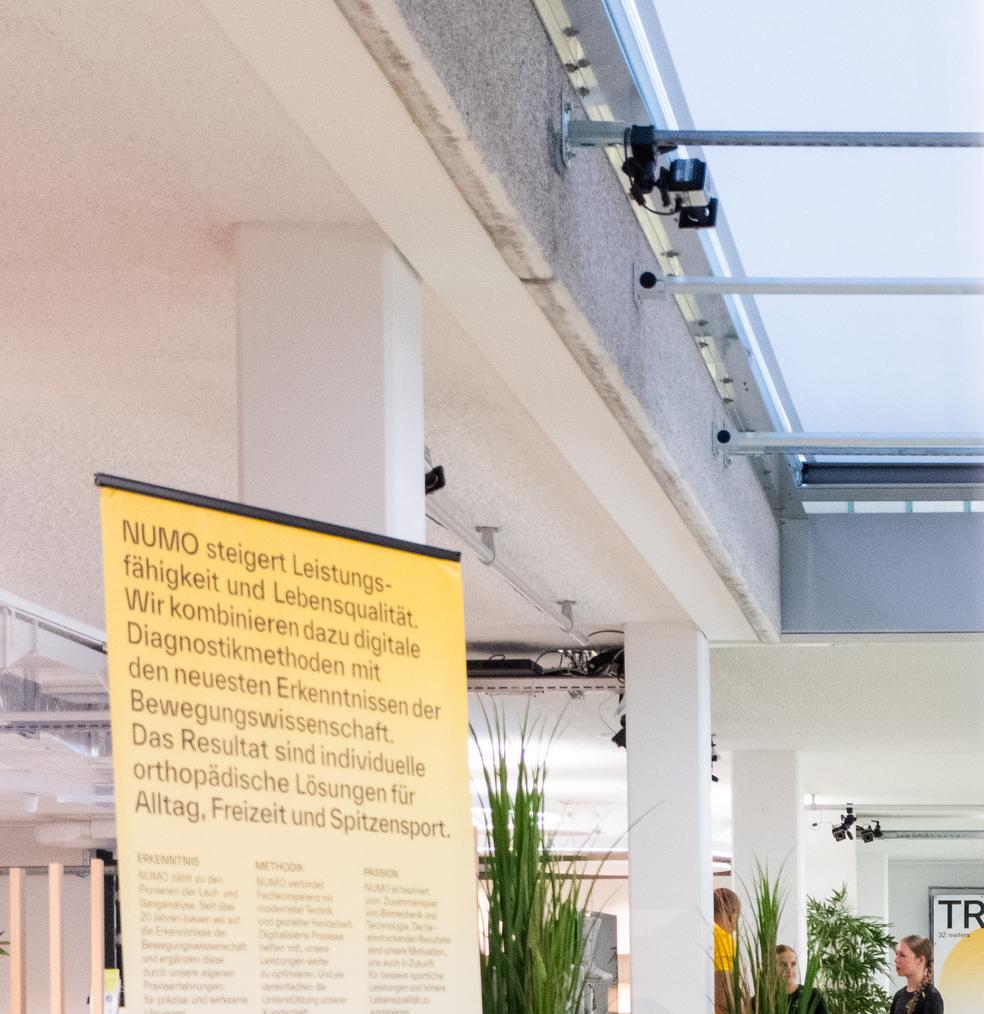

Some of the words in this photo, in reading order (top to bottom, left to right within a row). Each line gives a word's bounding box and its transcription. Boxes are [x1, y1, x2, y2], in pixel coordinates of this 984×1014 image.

[122, 519, 199, 555] NUMO
[206, 543, 287, 573] steigert
[293, 556, 392, 594] Leistungs-
[123, 555, 219, 592] fähigkeit
[227, 577, 264, 600] und
[274, 582, 418, 629] Lebensqualität.
[125, 588, 165, 614] Wir
[170, 597, 299, 637] kombinieren
[304, 623, 349, 647] dazu
[354, 631, 421, 659] digitale
[128, 622, 344, 677] Diagnostikmethoden
[352, 664, 381, 682] mit
[129, 658, 169, 683] den
[175, 667, 271, 696] neuesten
[278, 677, 408, 715] Erkenntnissen
[413, 700, 441, 720] der
[132, 689, 394, 744] Bewegungswissenschaft.
[132, 723, 174, 749] Das
[182, 729, 269, 760] Resultat
[276, 743, 315, 765] sind
[321, 745, 425, 778] individuelle
[134, 761, 289, 794] orthopädische
[296, 775, 386, 805] Lösungen
[392, 783, 415, 805] für
[135, 791, 206, 824] Alltag,
[212, 798, 287, 825] Freizeit
[293, 808, 325, 828] und
[331, 810, 451, 840] Spitzensport.
